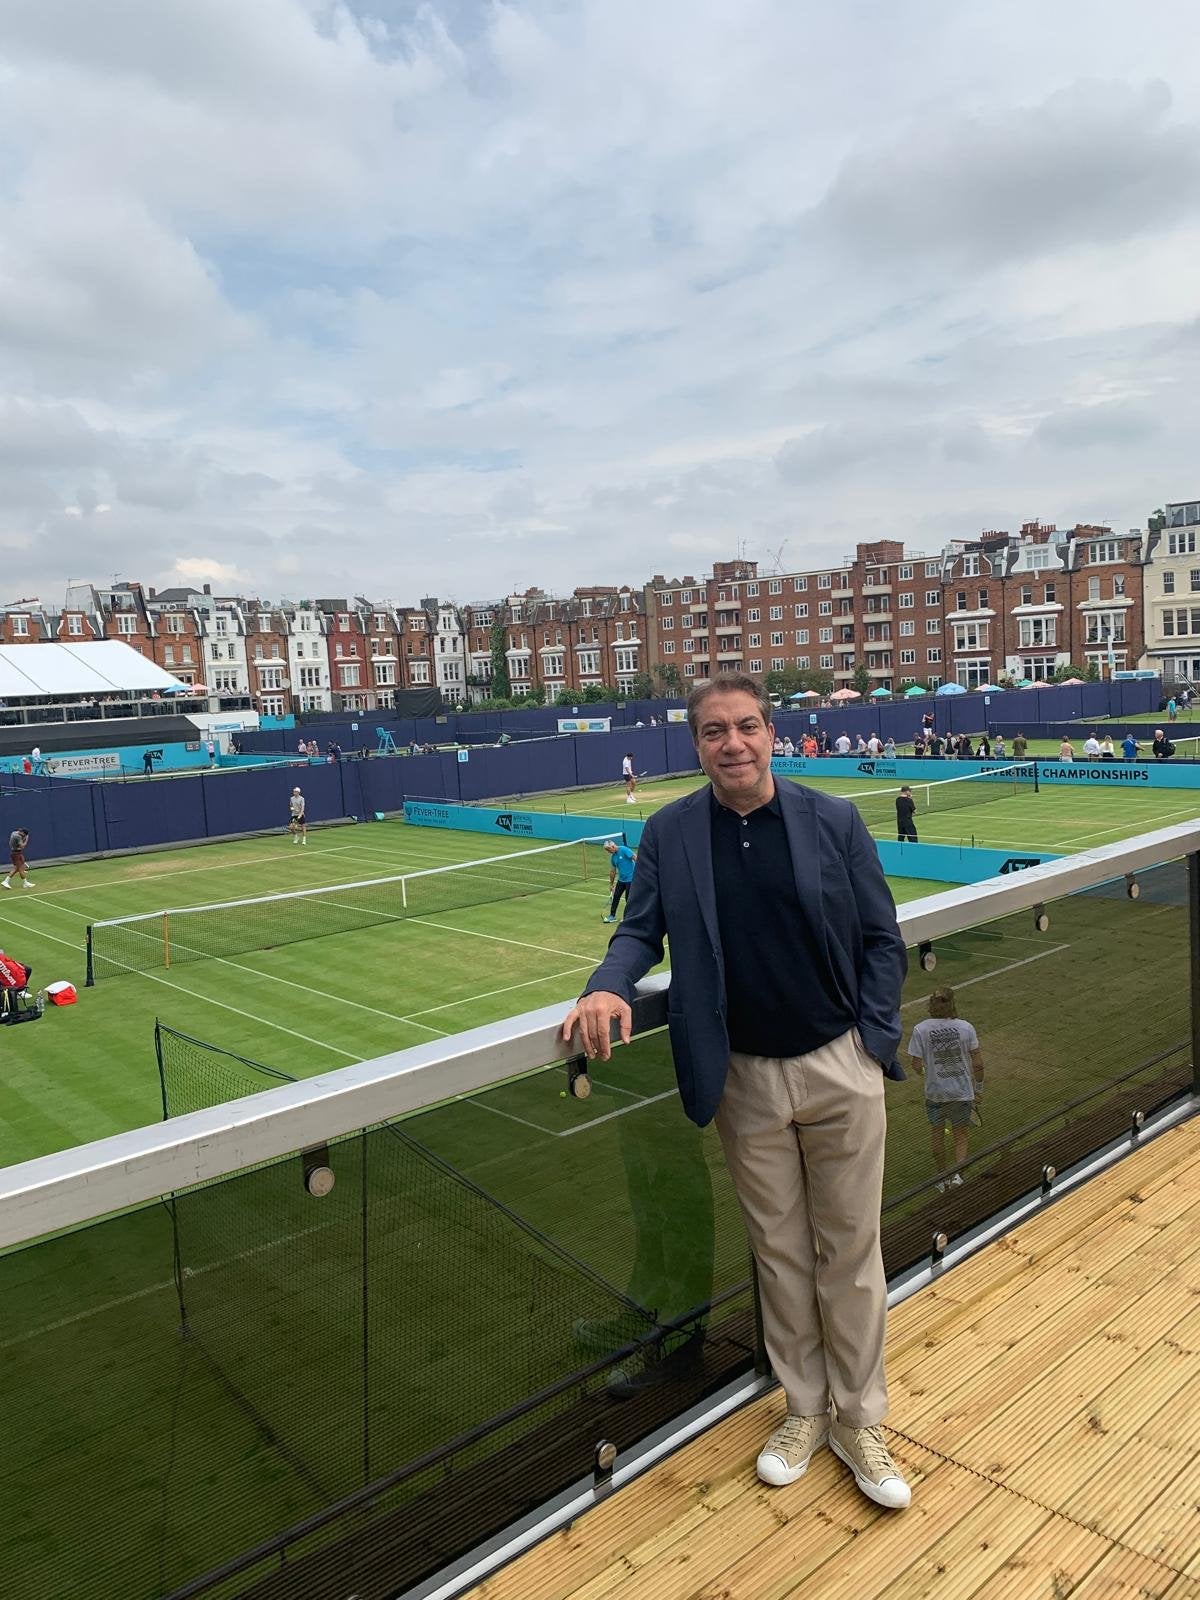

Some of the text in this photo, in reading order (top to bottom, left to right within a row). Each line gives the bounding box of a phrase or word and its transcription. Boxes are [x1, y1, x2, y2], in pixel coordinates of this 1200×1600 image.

[62, 757, 116, 767] FEVER-TREE
[980, 767, 1149, 780] FEVER-TREE CHAMPIONSHIPS
[414, 807, 449, 819] FEVER-TREE
[498, 817, 511, 827] LTA
